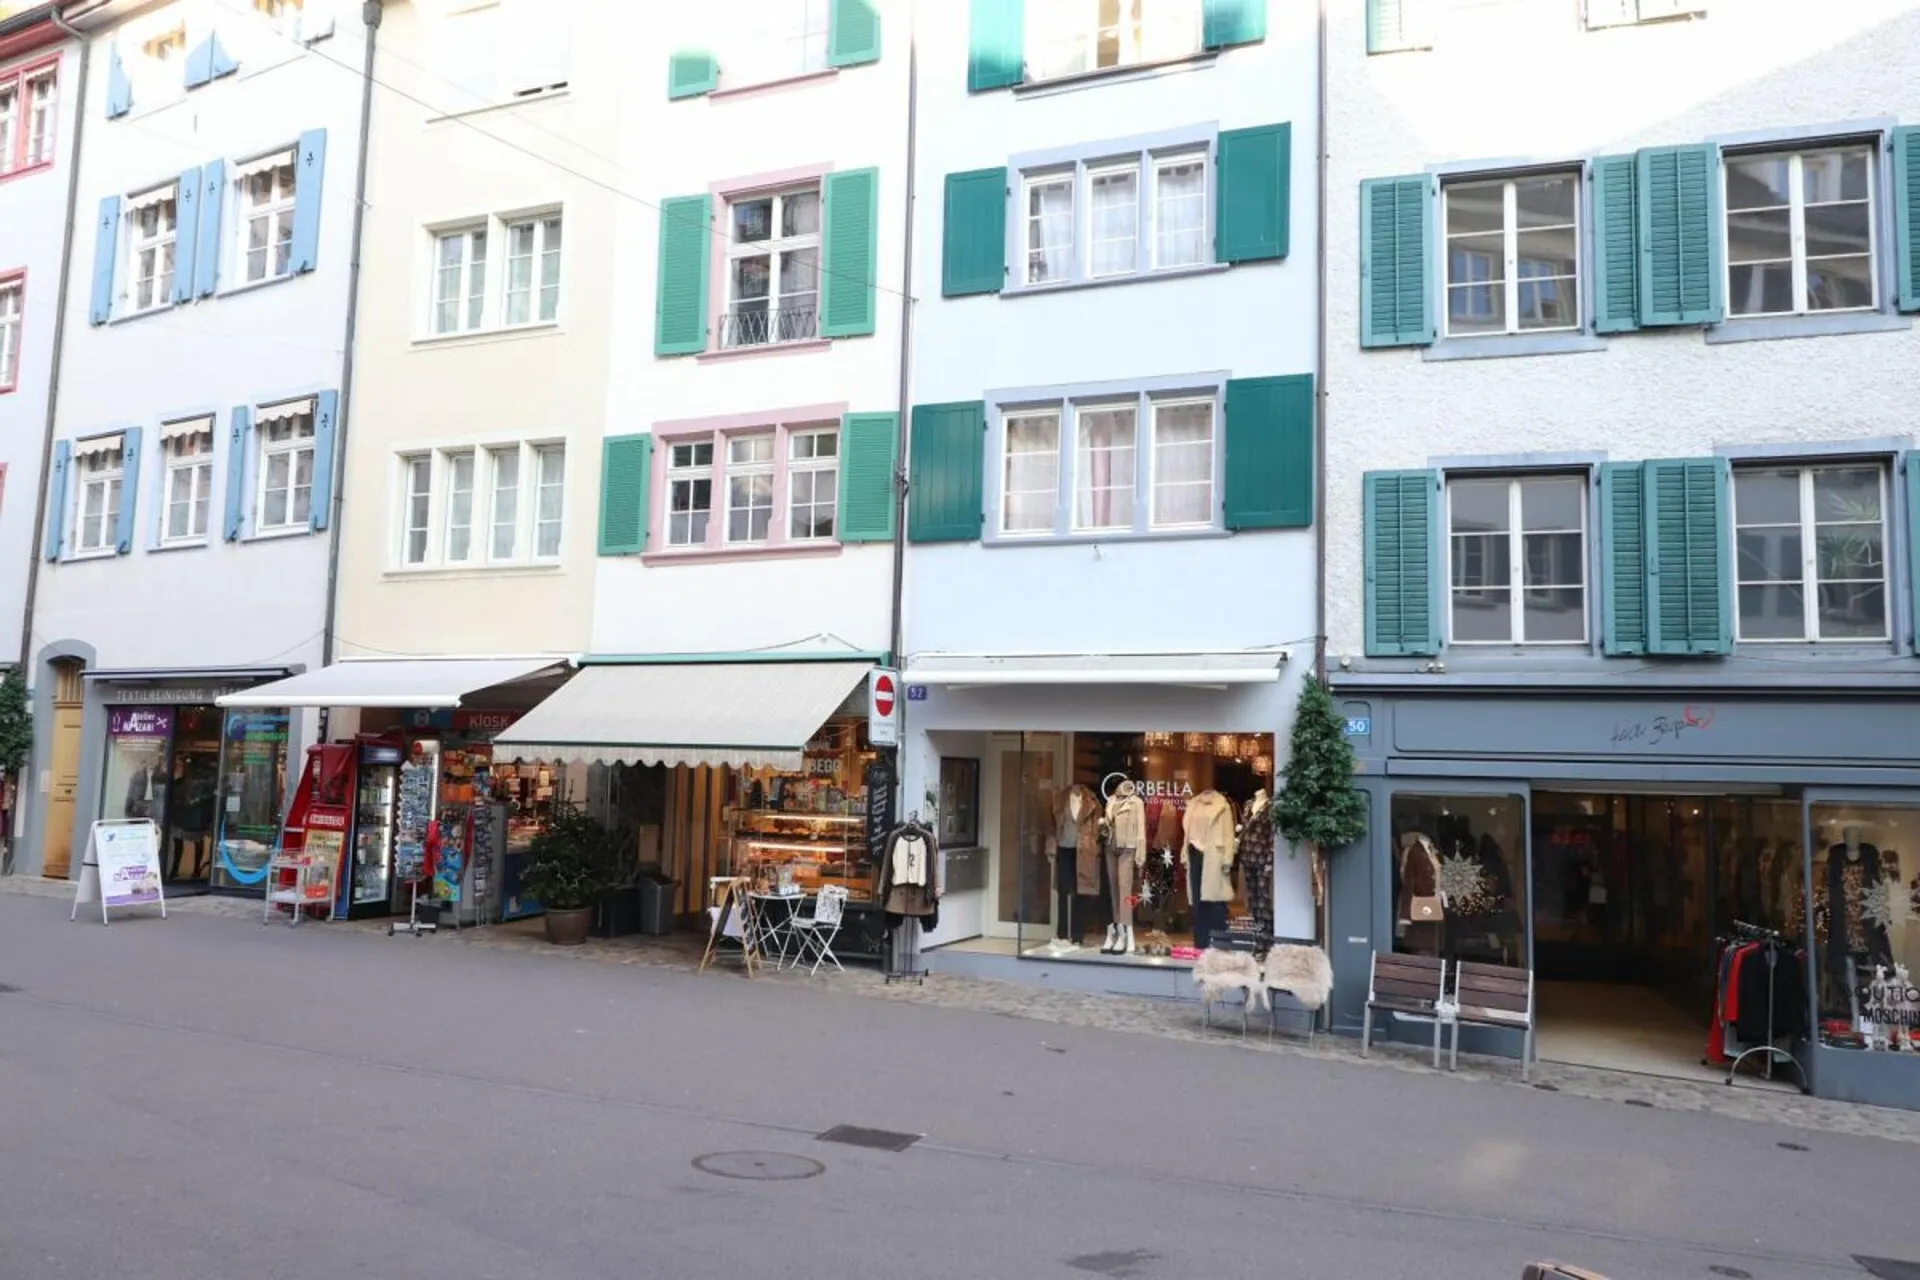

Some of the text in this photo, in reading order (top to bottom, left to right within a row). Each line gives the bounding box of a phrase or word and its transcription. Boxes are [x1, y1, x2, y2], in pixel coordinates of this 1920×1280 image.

[910, 687, 924, 696] 52
[1348, 720, 1365, 732] 50
[1101, 772, 1193, 801] CORBELLA
